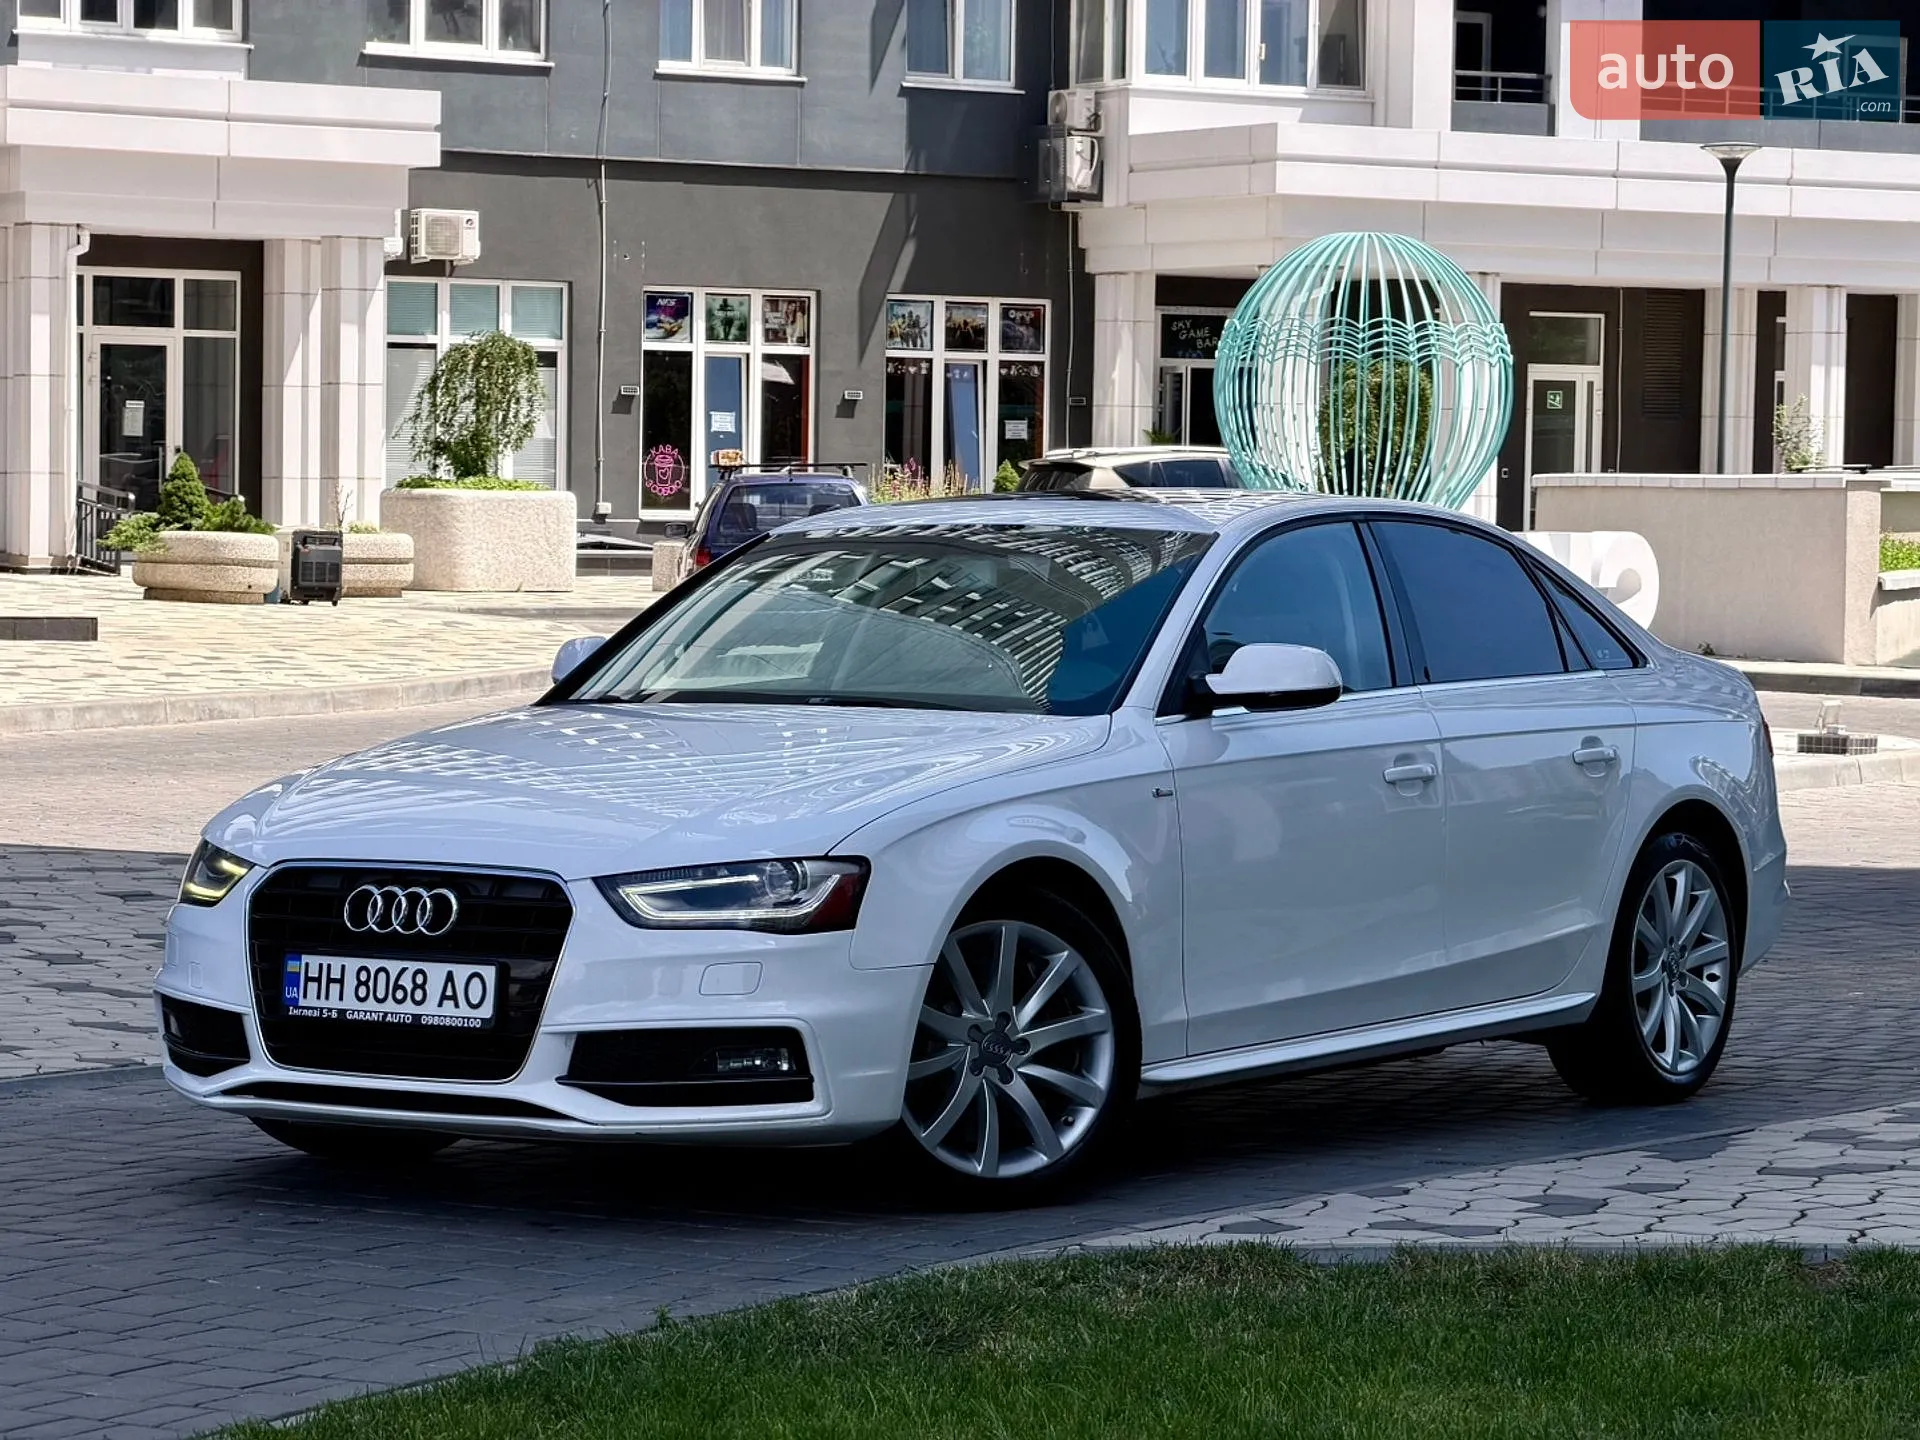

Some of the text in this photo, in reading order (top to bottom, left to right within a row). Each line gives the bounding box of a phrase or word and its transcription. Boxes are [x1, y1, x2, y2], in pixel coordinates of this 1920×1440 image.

[1171, 319, 1192, 331] SKY
[1179, 326, 1212, 340] GAME
[285, 986, 299, 998] UA
[302, 961, 487, 1010] HH 8068 AO
[346, 1010, 412, 1023] GARANT AUTO
[421, 1015, 482, 1028] 0980800100
